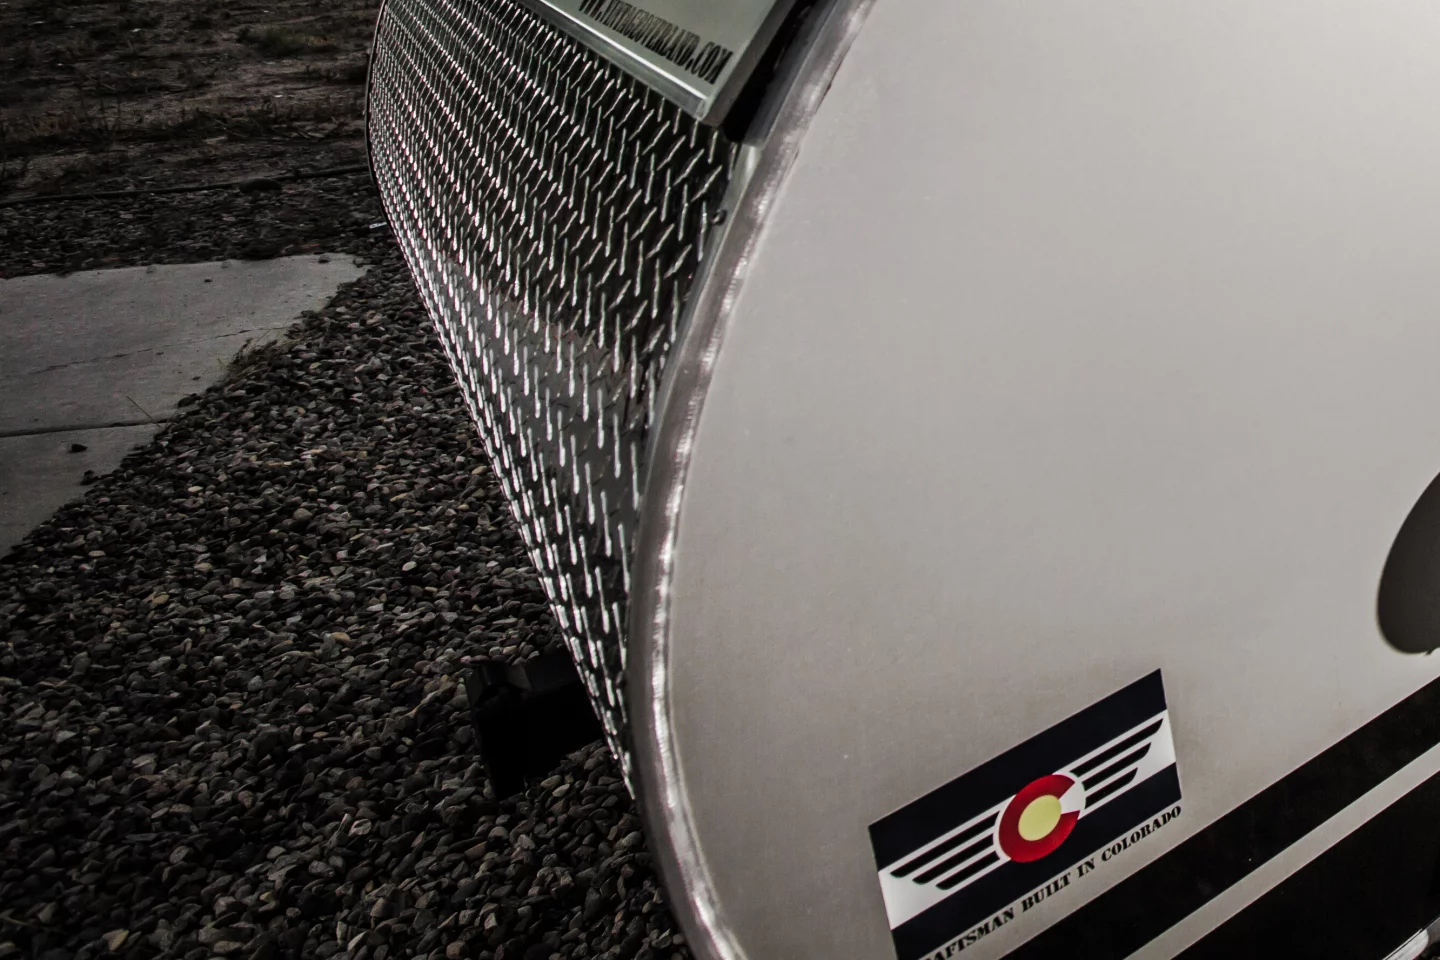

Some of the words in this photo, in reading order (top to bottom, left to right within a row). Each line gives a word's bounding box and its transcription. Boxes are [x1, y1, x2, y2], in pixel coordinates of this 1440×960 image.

[923, 907, 1016, 960] AFTSMAN
[1021, 872, 1072, 913] BUILT
[1076, 858, 1096, 879] IN
[1101, 805, 1182, 862] COLORADO
